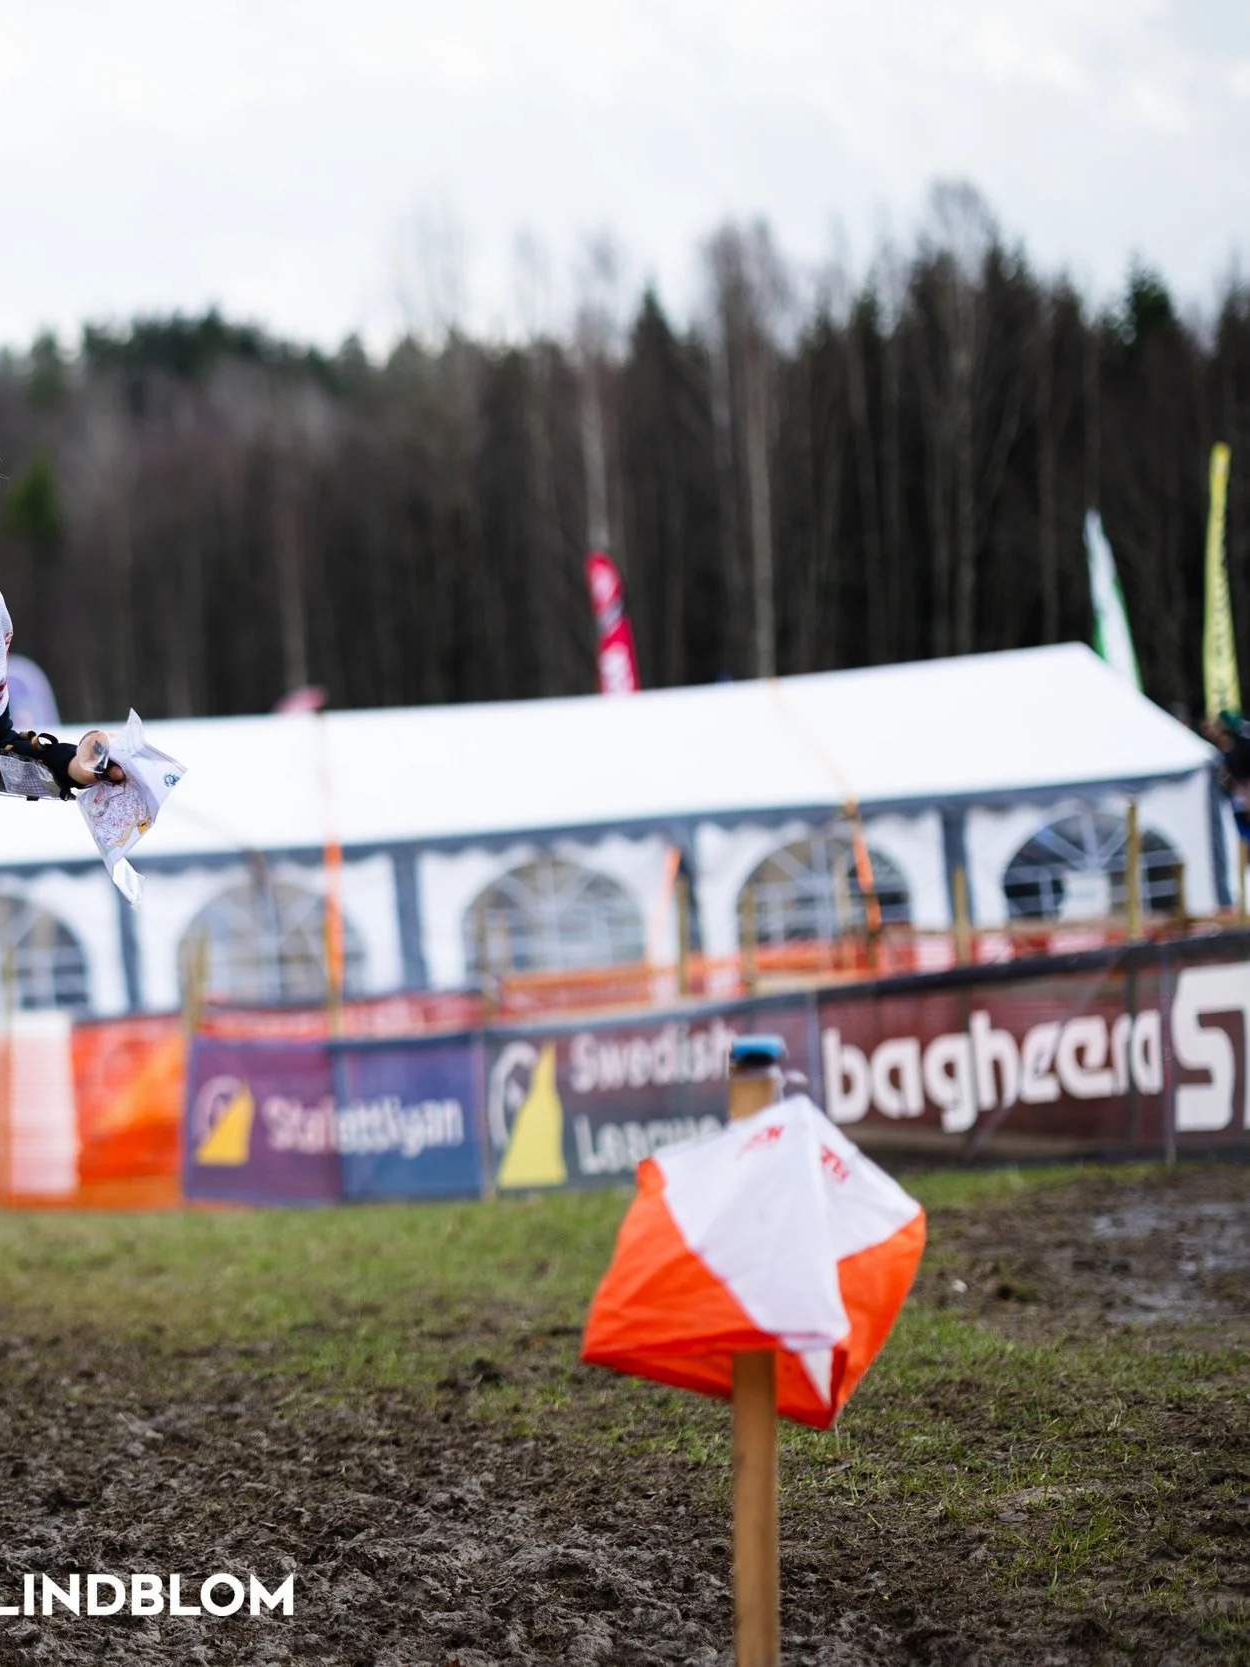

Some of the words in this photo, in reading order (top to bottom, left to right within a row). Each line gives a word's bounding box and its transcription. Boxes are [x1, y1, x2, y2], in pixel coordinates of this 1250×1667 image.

[570, 1015, 735, 1093] Swedish
[822, 1009, 1163, 1133] bagheera
[1171, 960, 1250, 1132] S
